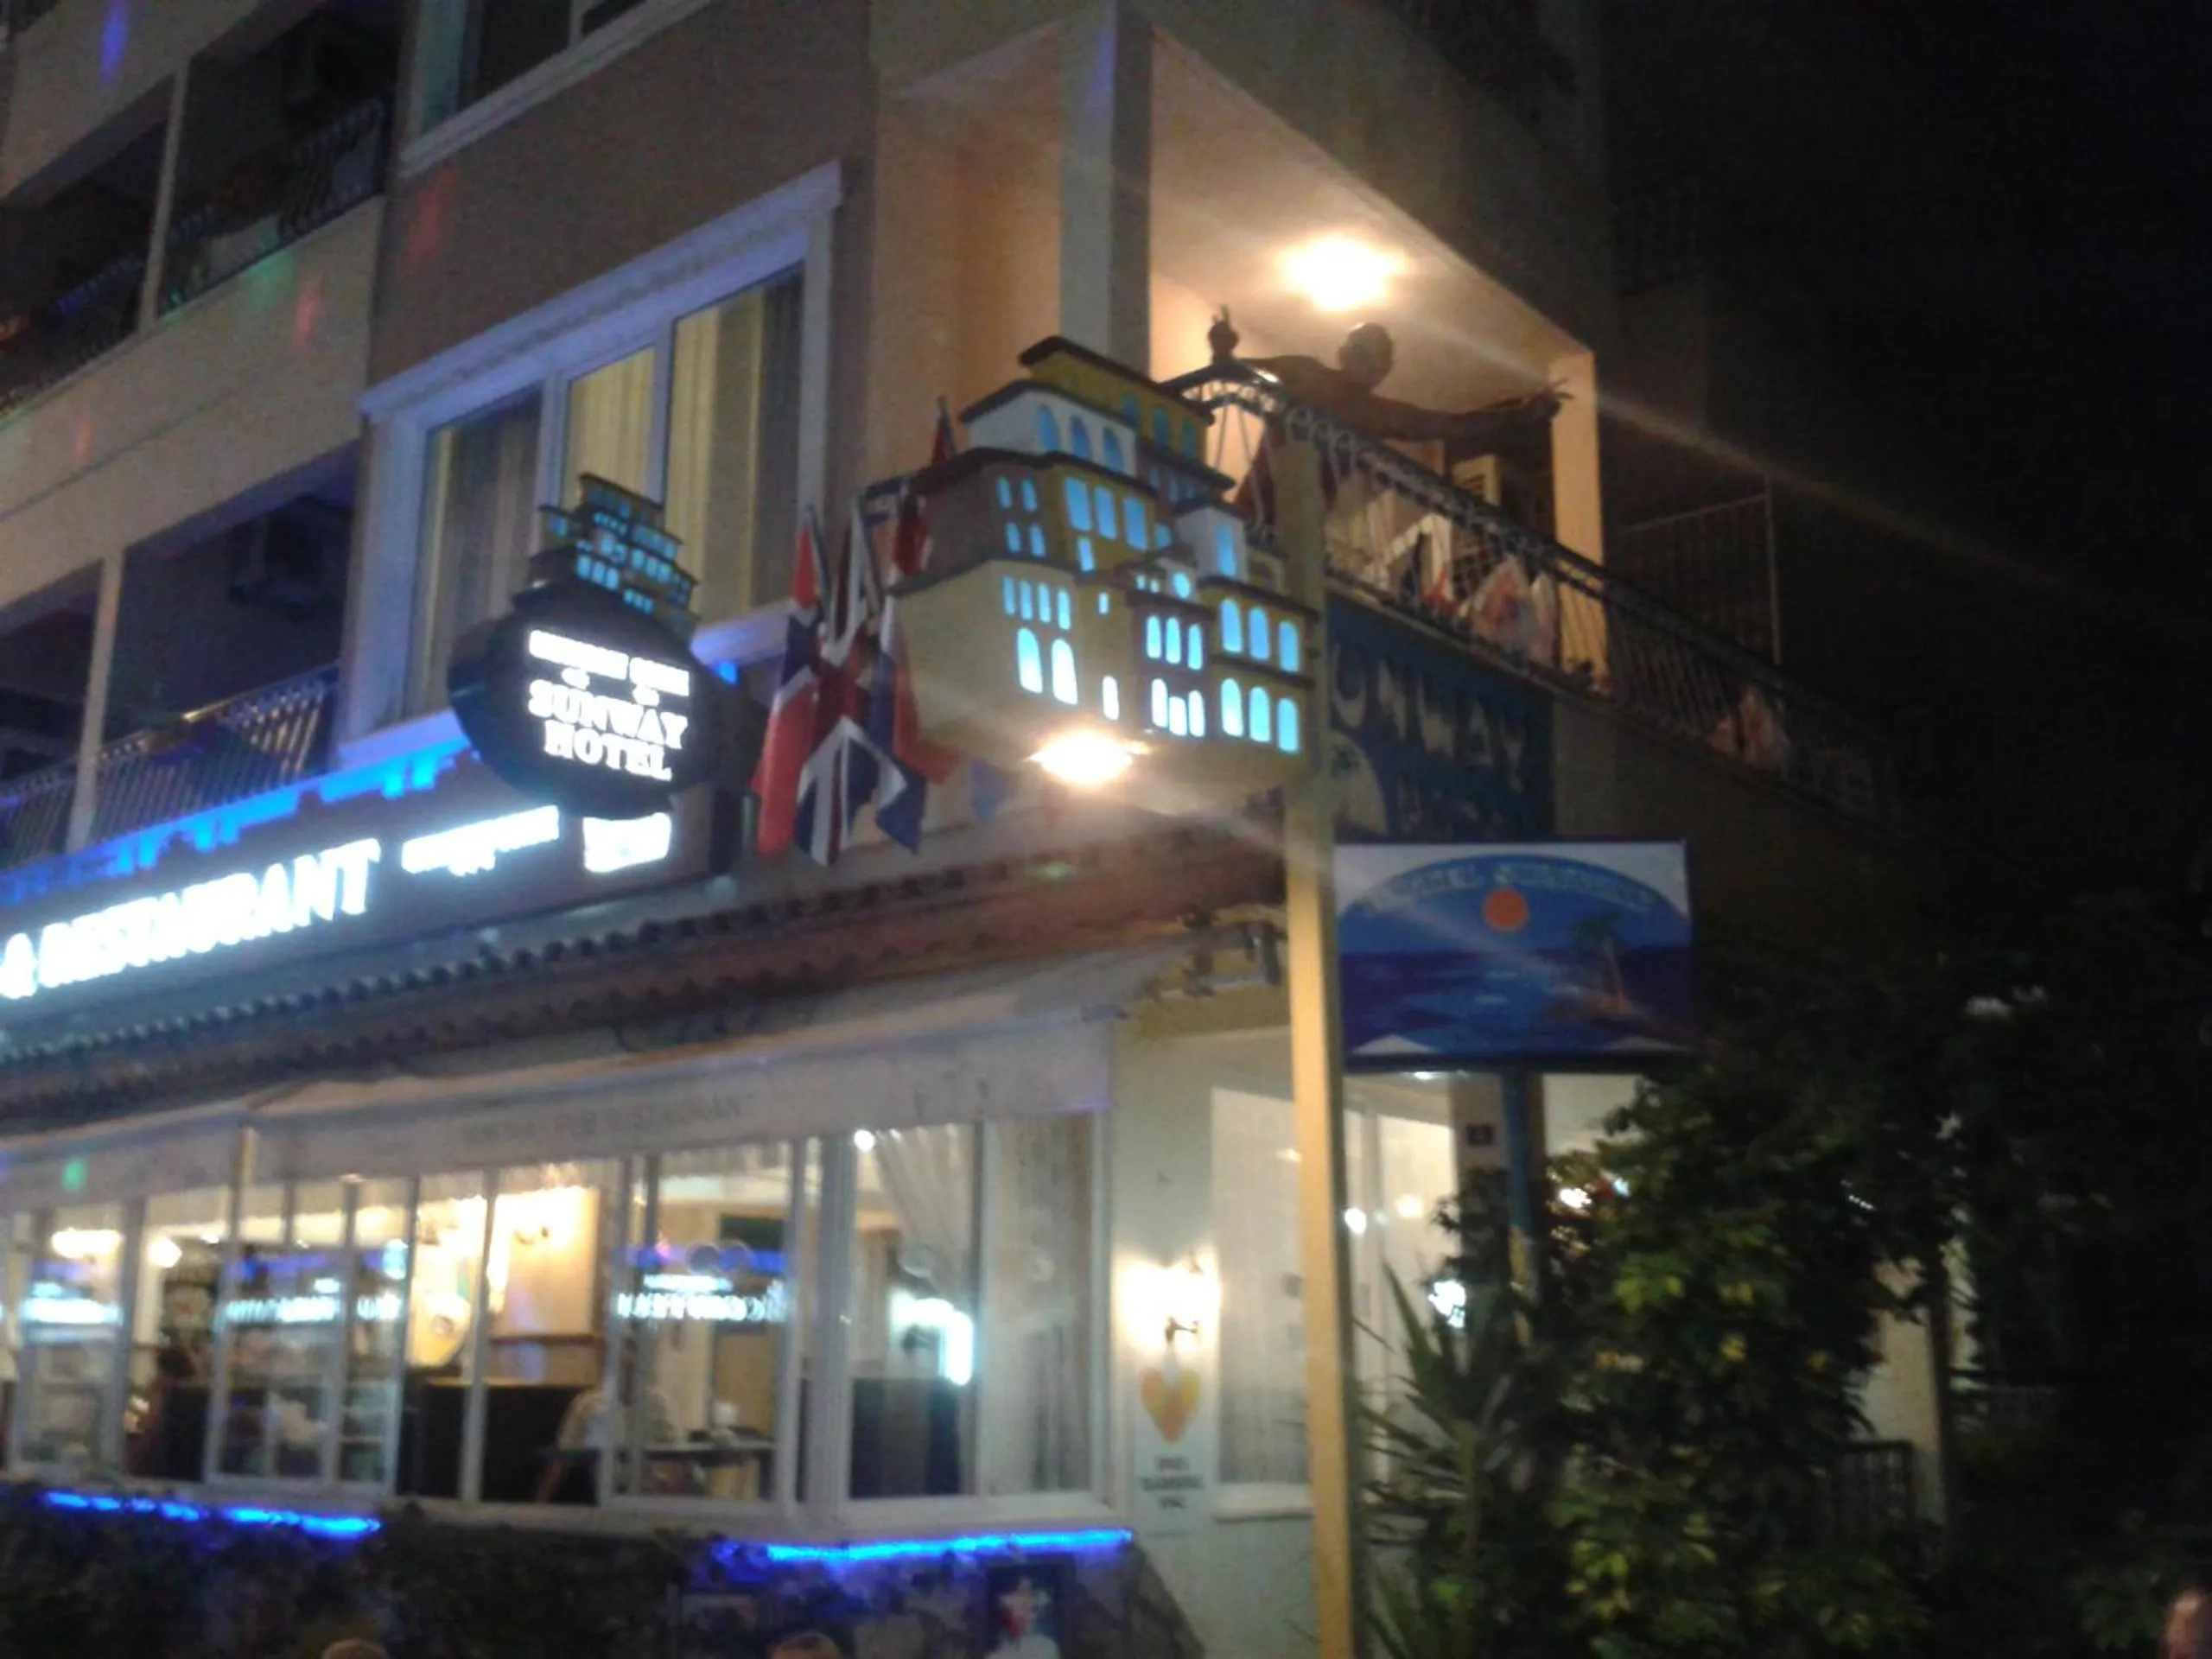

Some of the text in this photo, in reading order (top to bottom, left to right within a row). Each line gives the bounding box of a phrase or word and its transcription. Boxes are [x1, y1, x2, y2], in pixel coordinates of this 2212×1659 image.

[530, 680, 688, 748] SUNWAY
[545, 721, 671, 779] HOTEL
[39, 839, 381, 986] RESTAURANT
